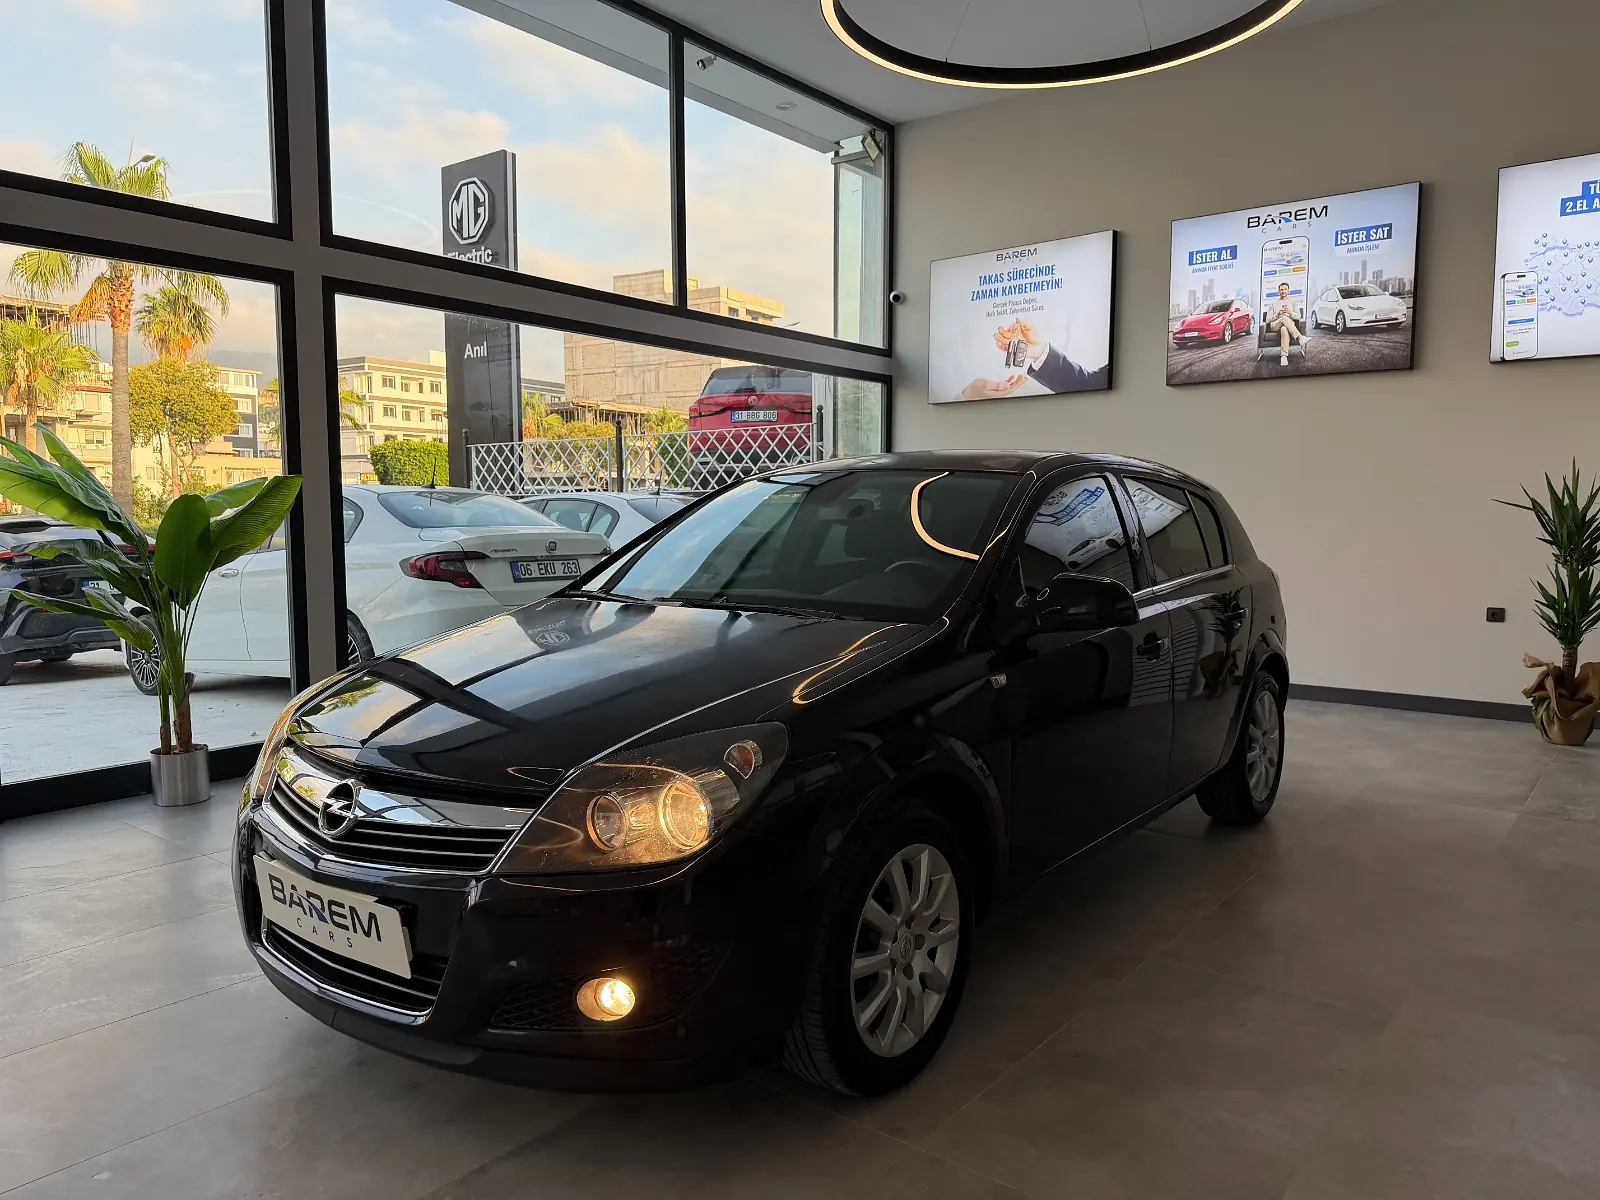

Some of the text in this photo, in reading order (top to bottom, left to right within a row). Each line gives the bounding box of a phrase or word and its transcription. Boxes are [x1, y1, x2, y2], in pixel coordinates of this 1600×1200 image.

[451, 183, 486, 239] MG
[1565, 199, 1588, 213] 2.EL
[1247, 205, 1328, 228] BAREM
[1262, 221, 1311, 233] CARS
[1337, 226, 1389, 245] İSTER SAT
[448, 246, 492, 264] ctric
[996, 248, 1038, 261] BAREM
[1193, 249, 1232, 264] İSTER AL
[978, 264, 1056, 286] TAKAS SÜRECİNDE
[971, 277, 1063, 301] ZAMAN KAYBETMEYİN!
[464, 341, 487, 359] Anıl
[735, 411, 743, 420] 31
[520, 561, 578, 576] 06 EKU 263
[268, 873, 382, 942] BAREM
[296, 917, 353, 948] CARS
